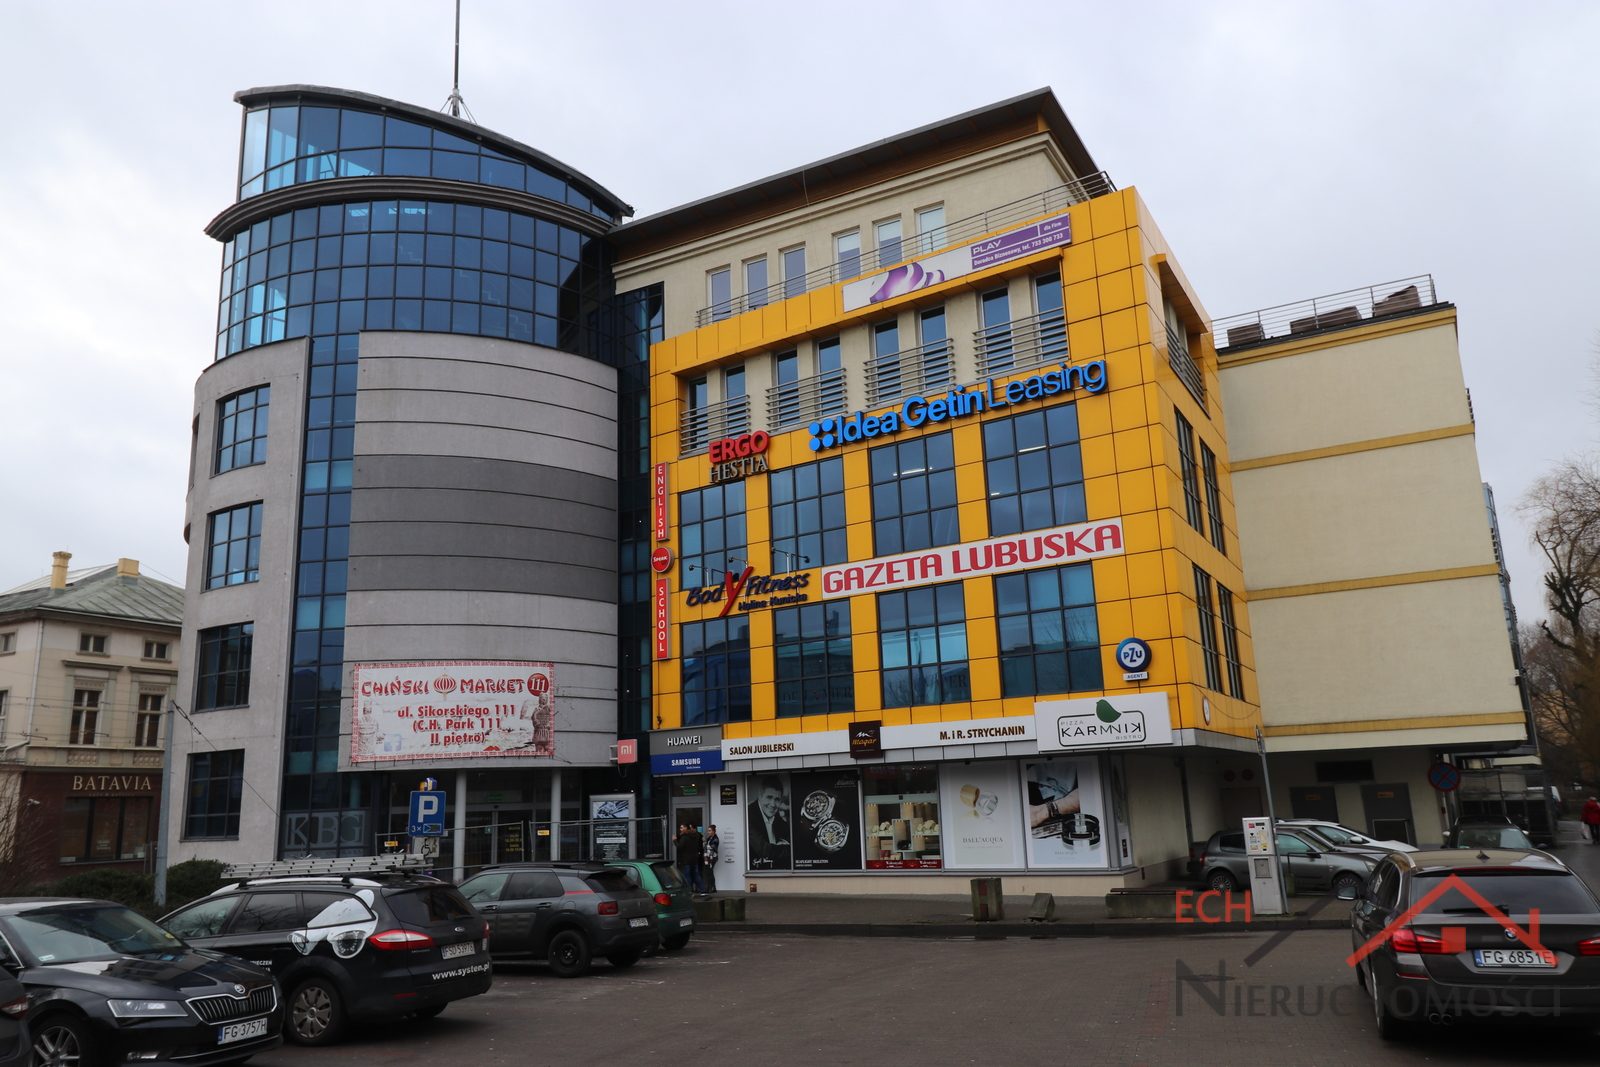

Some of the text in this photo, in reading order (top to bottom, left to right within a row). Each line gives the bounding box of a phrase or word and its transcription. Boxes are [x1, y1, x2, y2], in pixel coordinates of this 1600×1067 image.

[973, 240, 1001, 254] PLAY
[836, 360, 1107, 445] Idea Getin Leasing
[709, 430, 769, 463] ERGO
[710, 455, 768, 482] HESTIA
[823, 524, 1122, 593] GAZETA LUBUSKA
[745, 573, 811, 597] Fitness
[738, 600, 767, 612] Halina
[658, 587, 666, 652] SCHOOL
[1123, 647, 1143, 663] PZU
[361, 676, 546, 697] CHIŃSKI MARKET 111
[397, 704, 516, 719] ul. Sikorskiego 111
[413, 718, 501, 732] (C.H. Park 111
[939, 731, 951, 740] M.
[957, 730, 966, 739] R.
[967, 725, 1025, 739] STRYCHANIN
[1061, 722, 1142, 738] KARMNIK
[667, 735, 702, 747] HUAWEI
[729, 746, 753, 756] SALON
[752, 742, 795, 754] JUBILERSKI
[671, 758, 701, 767] SAMSUNG
[73, 776, 151, 790] BATAVIA
[418, 795, 438, 823] P
[286, 813, 361, 848] KBG
[1482, 951, 1504, 963] FG
[432, 961, 490, 980] www.systen.pl
[224, 1019, 267, 1039] FG 3757H
